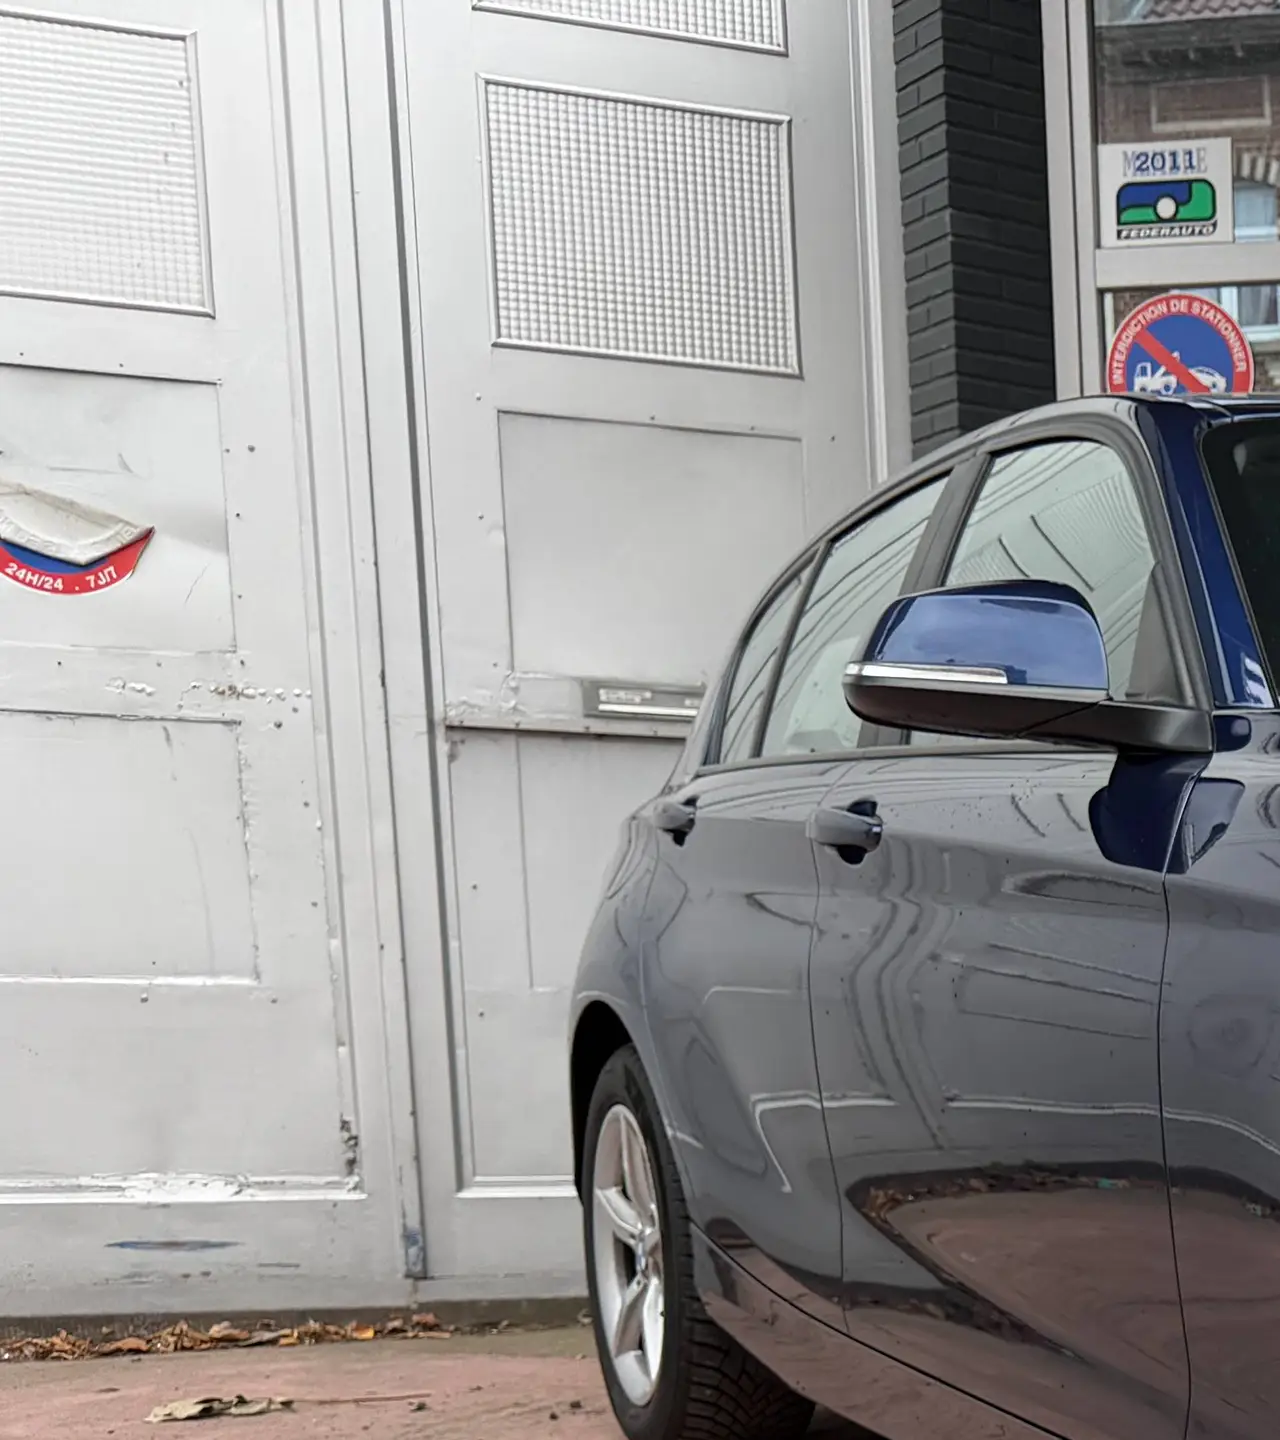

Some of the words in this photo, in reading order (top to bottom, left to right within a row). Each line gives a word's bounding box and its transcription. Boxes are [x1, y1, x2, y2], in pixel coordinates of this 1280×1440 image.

[1134, 150, 1197, 173] 2011
[1120, 222, 1214, 239] FEDERAUTO
[1112, 300, 1168, 385] INTERDICTION
[1170, 299, 1188, 313] DE
[1191, 299, 1248, 373] STATIONNER
[5, 562, 64, 591] 24H/24
